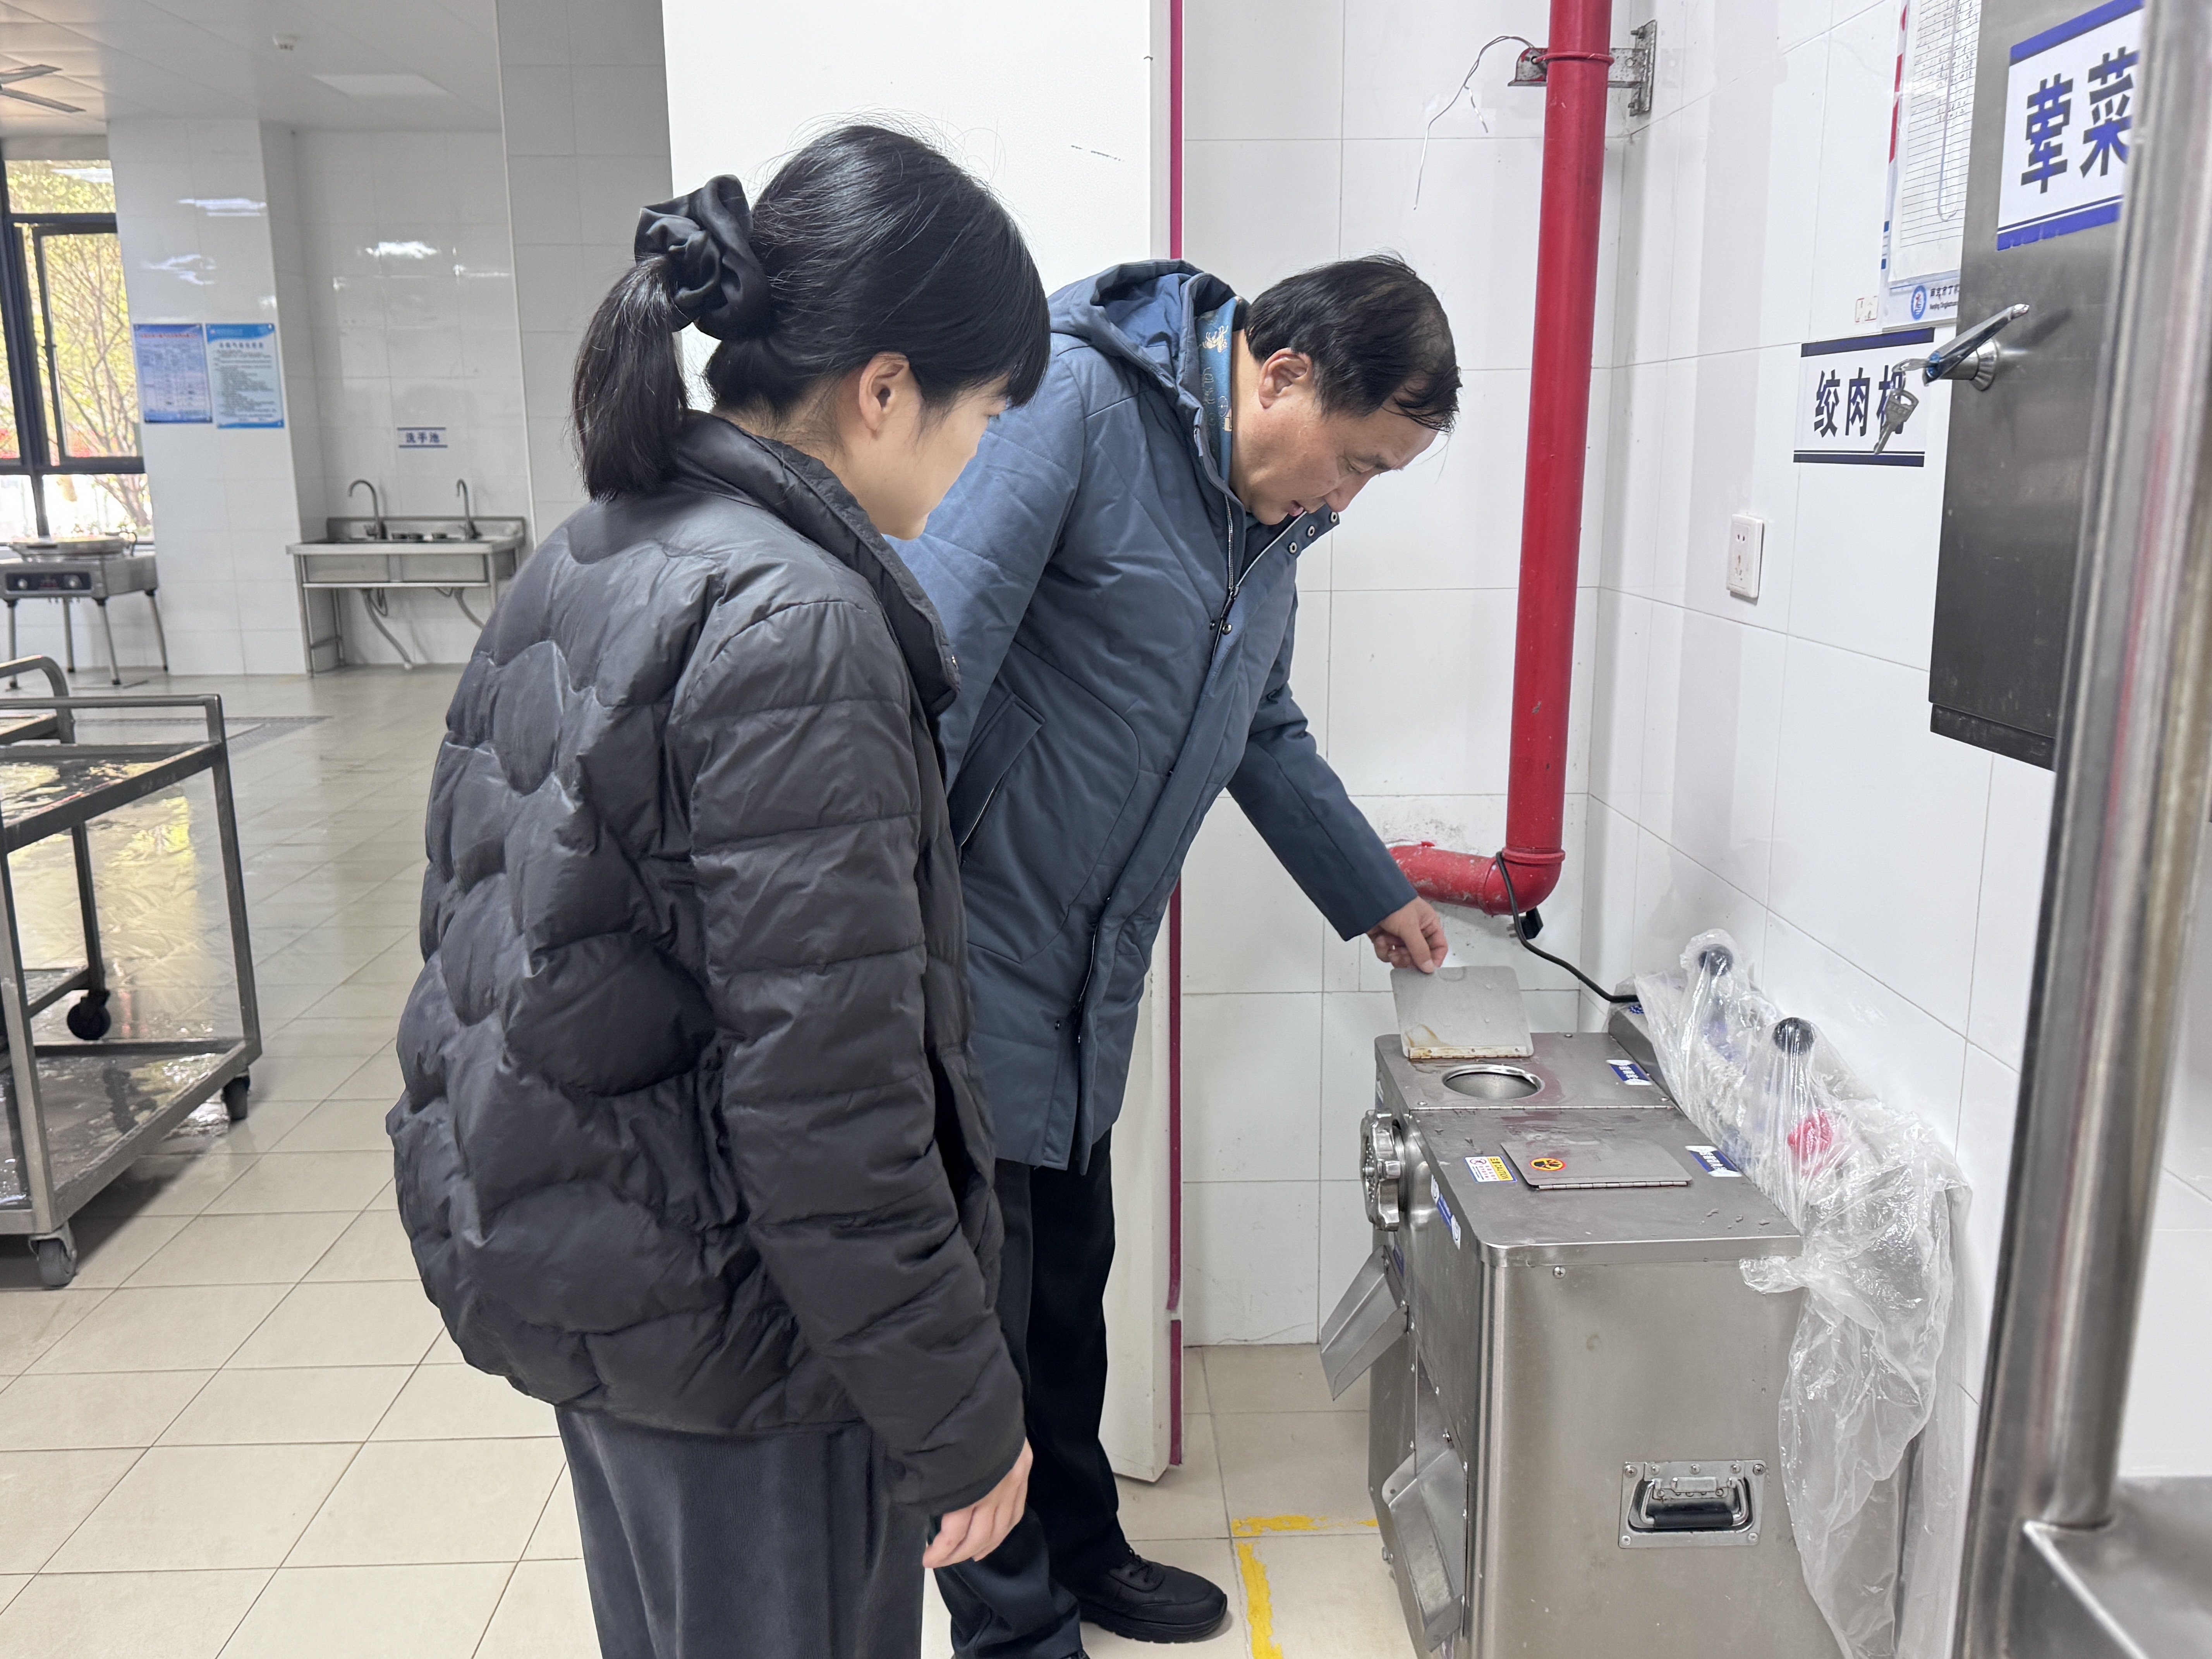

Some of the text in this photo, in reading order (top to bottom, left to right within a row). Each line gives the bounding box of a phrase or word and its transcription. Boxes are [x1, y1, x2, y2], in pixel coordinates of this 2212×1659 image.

[2021, 46, 2138, 194] 荤菜
[405, 432, 440, 443] 洗手池
